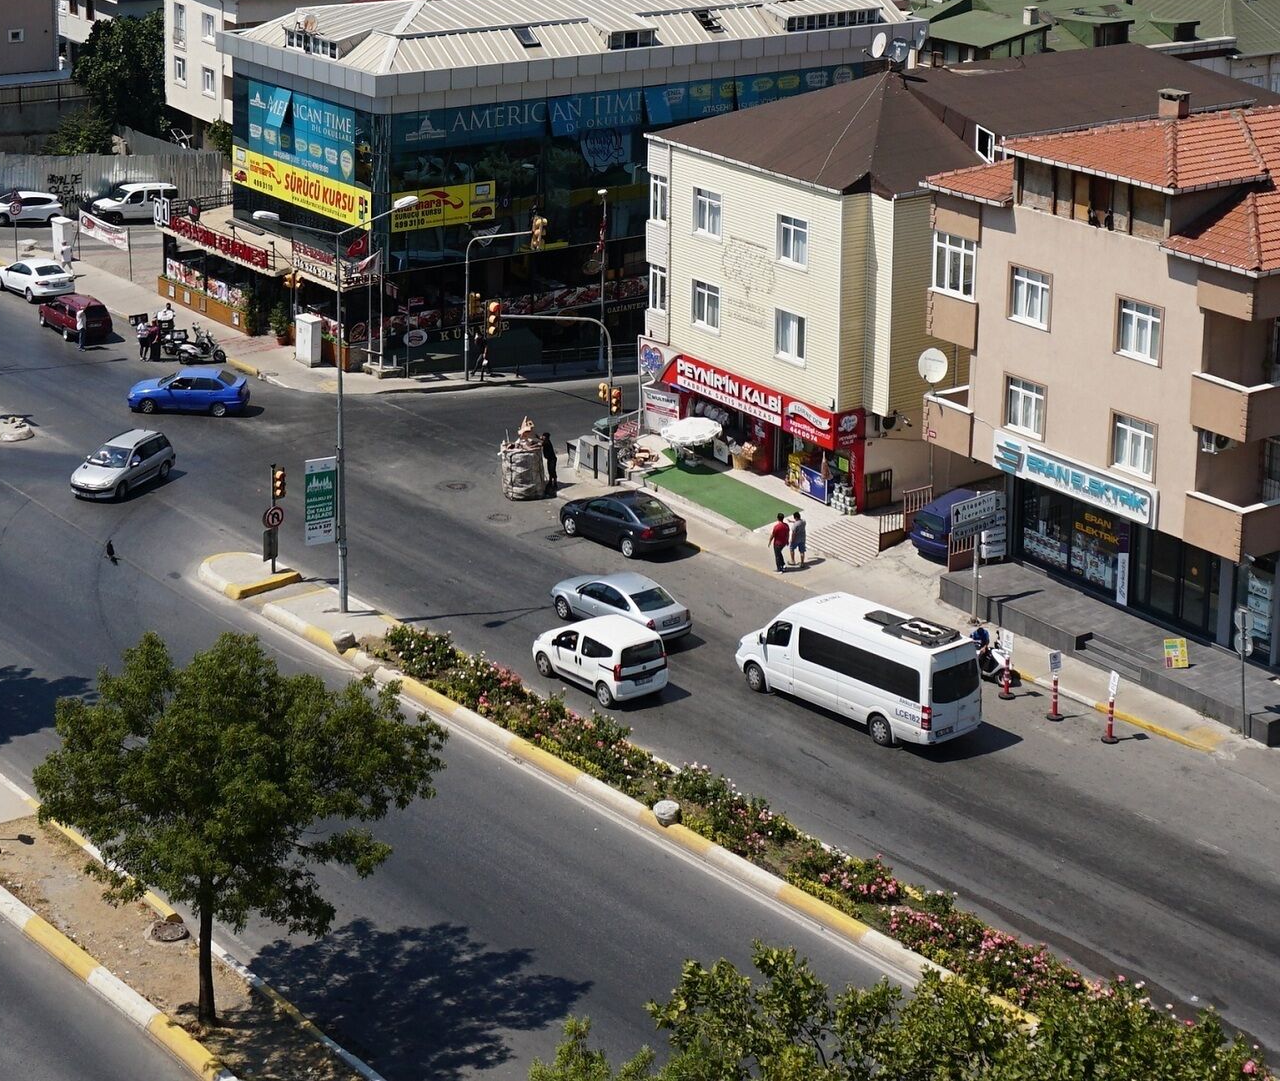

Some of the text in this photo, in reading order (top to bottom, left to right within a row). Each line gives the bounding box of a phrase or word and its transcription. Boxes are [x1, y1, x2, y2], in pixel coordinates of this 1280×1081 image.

[325, 111, 352, 134] TIME
[451, 98, 582, 132] AMERICAN
[592, 90, 651, 116] TIME
[323, 127, 352, 143] OKULLARI
[284, 171, 355, 213] SÜRÜCÜ KURSU
[12, 205, 21, 213] 30
[154, 200, 169, 224] 01
[421, 208, 442, 217] KURSU
[677, 358, 739, 397] PEYNİR'İN
[741, 384, 782, 414] KALBİ
[789, 426, 801, 437] 444
[1026, 453, 1071, 484] ERAN
[1085, 512, 1112, 529] ERAN
[1075, 521, 1120, 545] ELEKTRİK
[895, 708, 920, 723] LCE182
